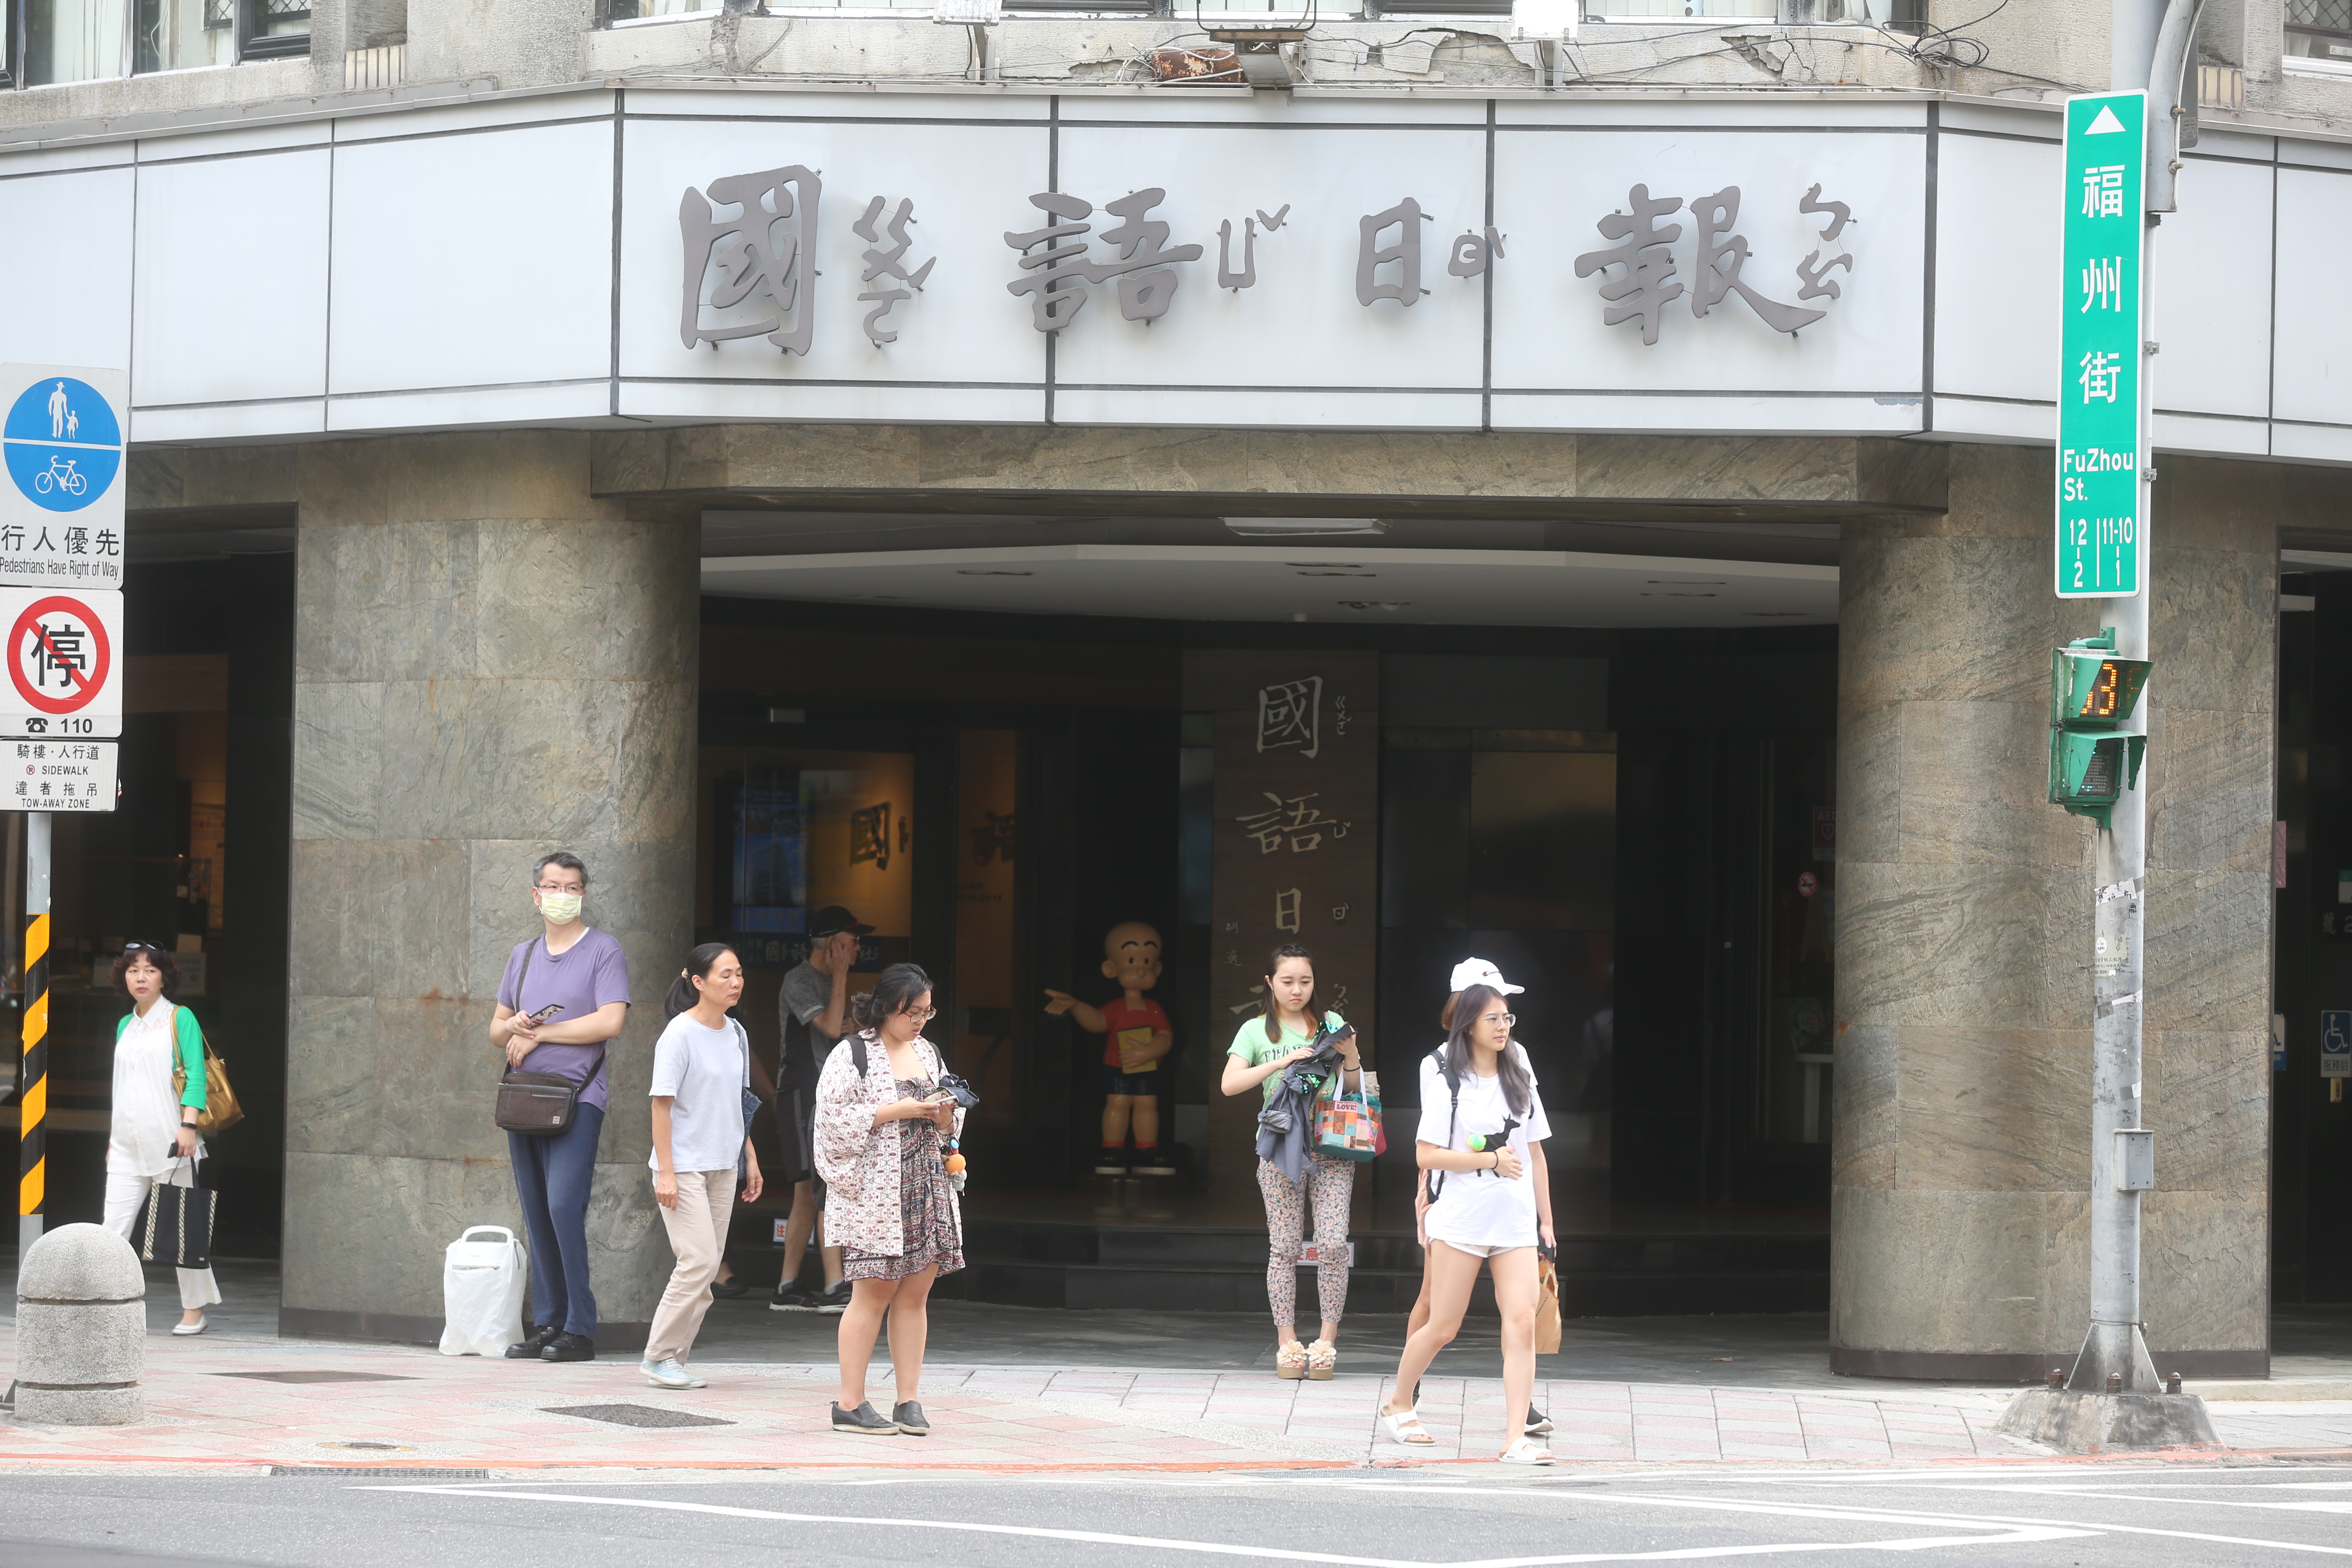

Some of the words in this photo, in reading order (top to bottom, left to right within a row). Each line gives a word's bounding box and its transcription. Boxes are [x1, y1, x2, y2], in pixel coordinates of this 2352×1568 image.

[679, 165, 1827, 356] 國語日報
[2079, 165, 2126, 404] 福州街
[2063, 448, 2134, 473] FuZhou
[2063, 477, 2089, 501] St.
[1, 524, 120, 556] 行人優先
[2070, 518, 2087, 546] 12
[2103, 517, 2134, 544] 11-10
[0, 557, 45, 574] Pedestrians
[47, 559, 67, 575] Have
[69, 560, 89, 579] Right
[92, 561, 100, 576] of
[102, 561, 119, 581] Way
[31, 623, 86, 687] 停
[61, 718, 93, 733] 110
[42, 765, 89, 775] SIDEWALK
[15, 780, 98, 797] 違者拖吊
[22, 798, 65, 808] TOW-AWAY
[68, 799, 90, 808] ZONE
[1229, 676, 1336, 1015] 國語日
[2323, 1059, 2349, 1072] 服務鈴
